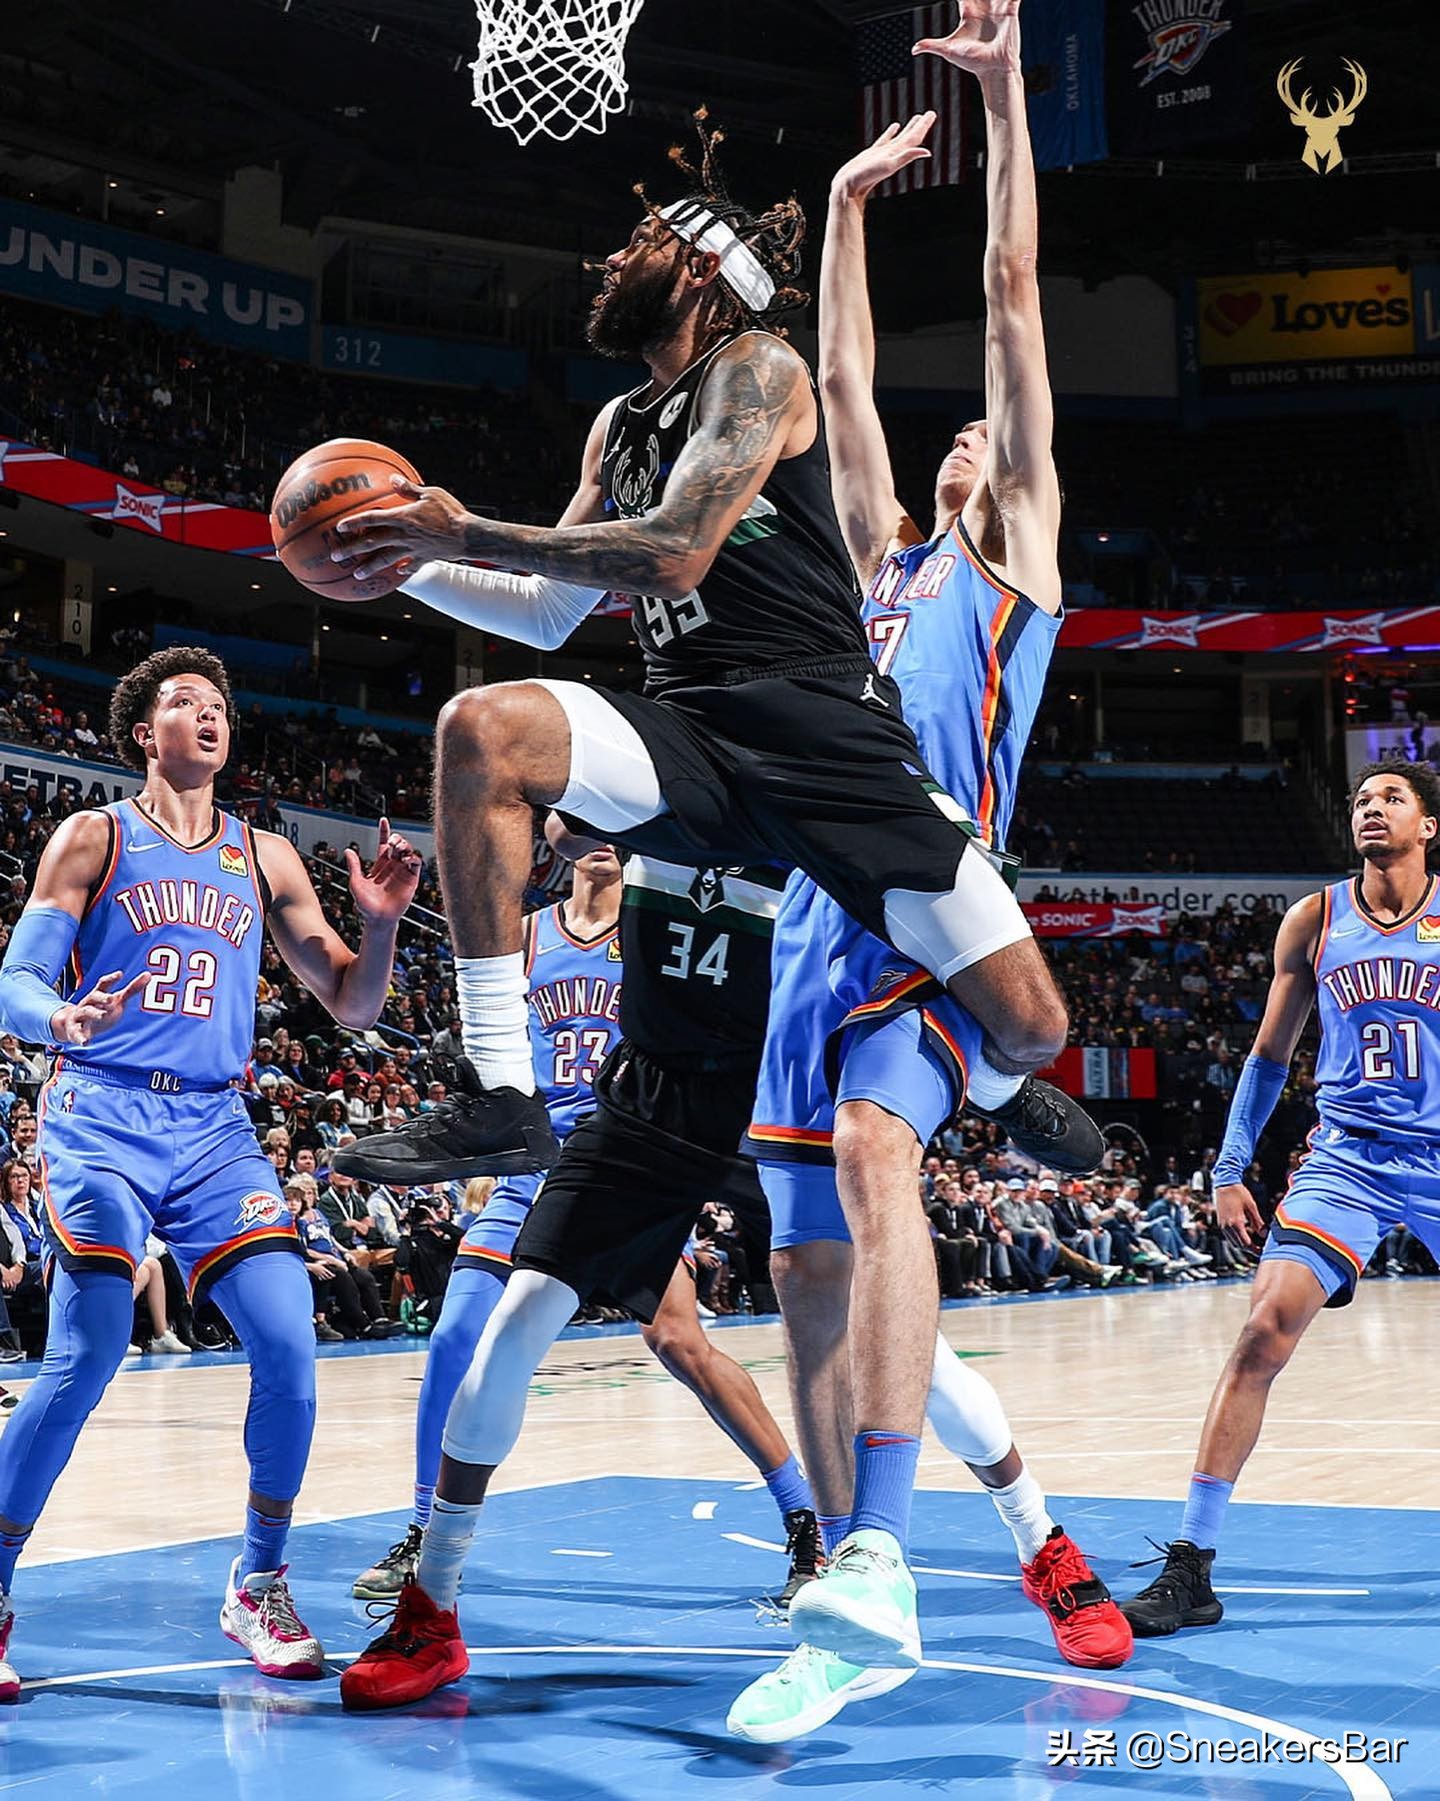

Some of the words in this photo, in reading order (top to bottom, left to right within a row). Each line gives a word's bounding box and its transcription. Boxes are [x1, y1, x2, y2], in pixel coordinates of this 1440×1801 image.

[1065, 33, 1080, 111] OKLAHOMA
[222, 283, 304, 331] UP
[335, 336, 381, 366] 312
[1229, 369, 1298, 385] BRING
[1304, 365, 1348, 381] THE
[119, 494, 159, 520] SONIC
[276, 472, 372, 529] Wilson
[872, 553, 956, 609] NER
[864, 611, 911, 678] 7
[1148, 623, 1192, 638] SONIC
[1329, 623, 1376, 637] SONIC
[115, 879, 255, 950] THUNDER
[1041, 912, 1093, 927] SONIC
[1119, 915, 1156, 926] SONIC
[661, 921, 730, 986] 34
[141, 944, 218, 1020] 22
[553, 1028, 611, 1086] 23
[1361, 1020, 1420, 1081] 21
